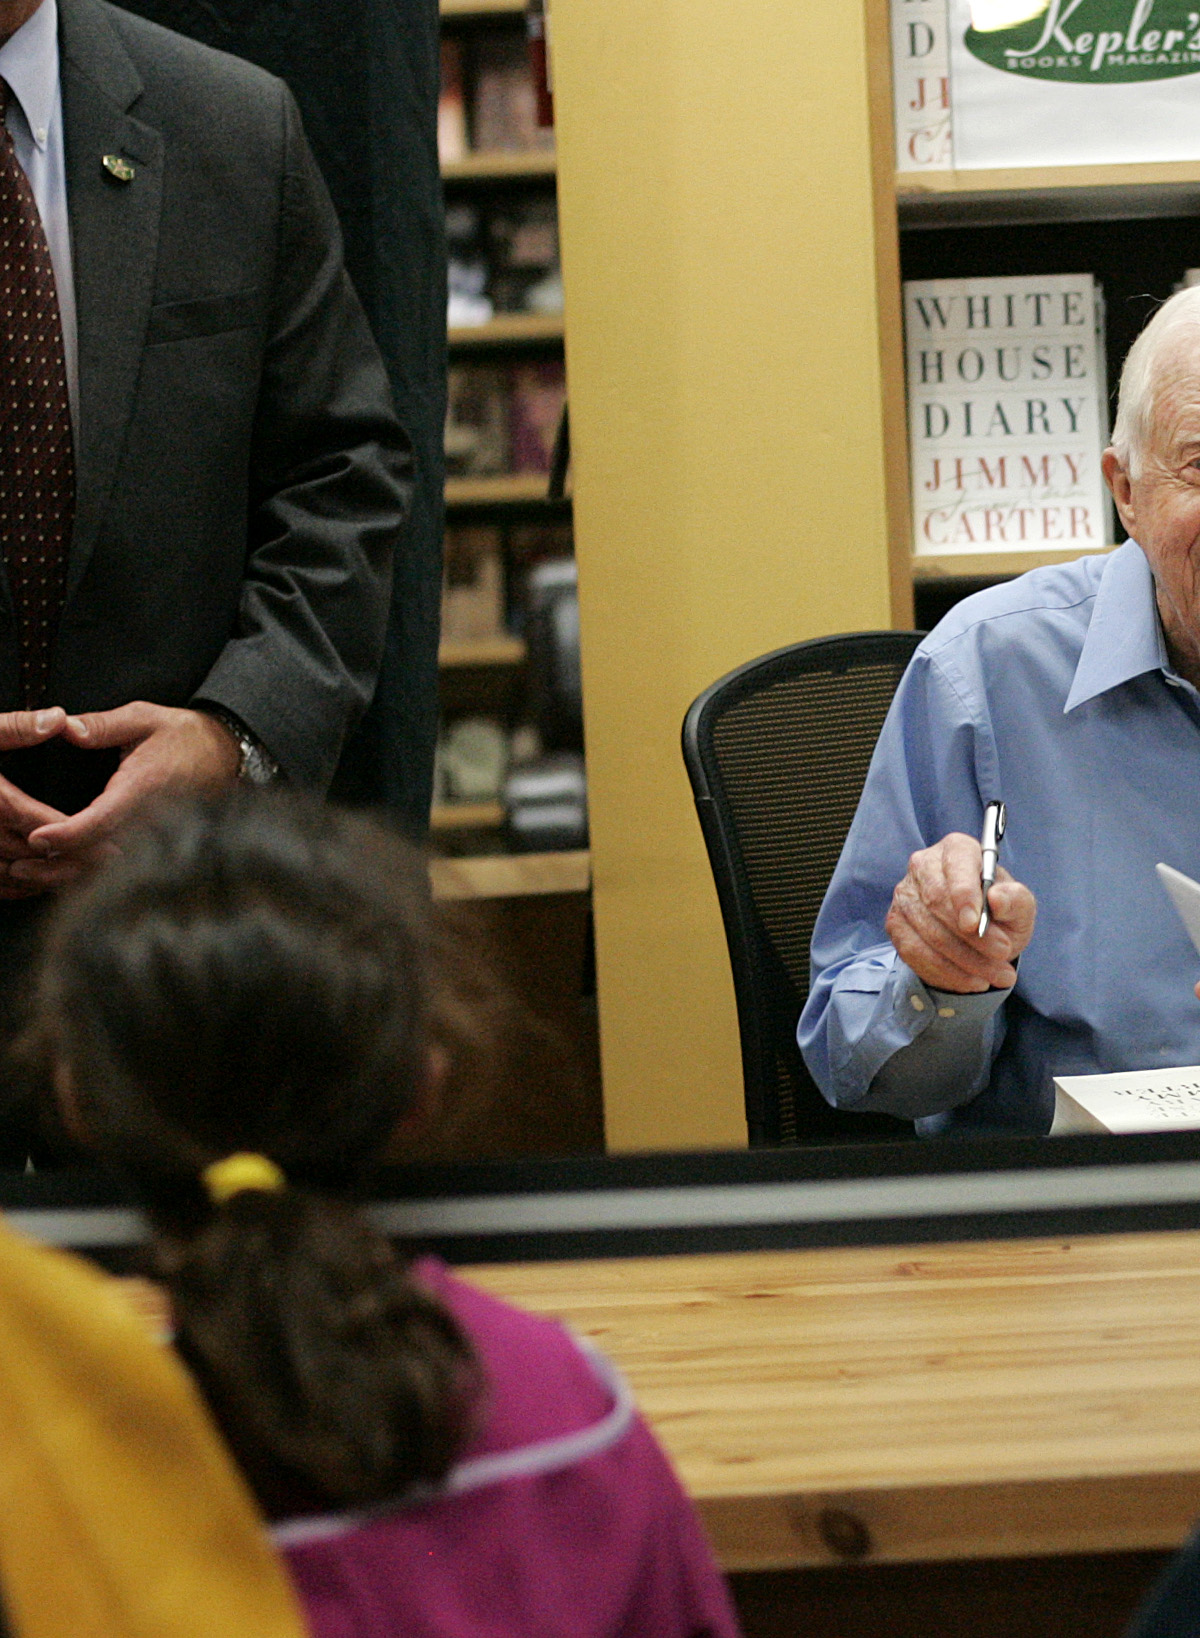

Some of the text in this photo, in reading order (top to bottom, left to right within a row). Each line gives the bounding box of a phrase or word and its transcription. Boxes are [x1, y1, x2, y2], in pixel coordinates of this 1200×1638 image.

[1006, 55, 1083, 69] BOOKS
[914, 291, 1085, 331] WHITE
[919, 345, 1087, 384] HOUSE
[923, 398, 1085, 438] DIARY
[925, 453, 1085, 490] JIMMY
[923, 507, 1094, 543] CARTER
